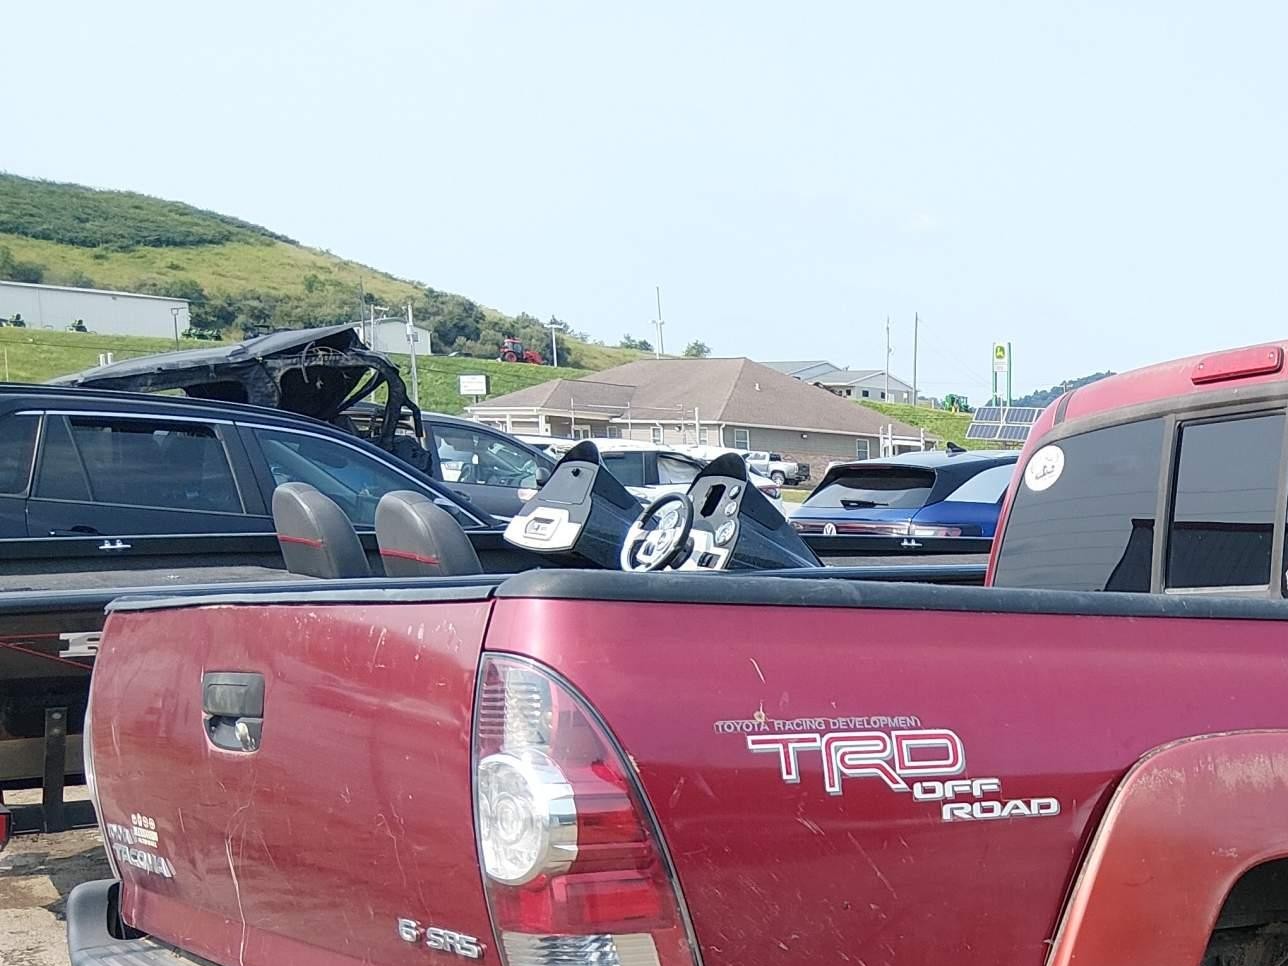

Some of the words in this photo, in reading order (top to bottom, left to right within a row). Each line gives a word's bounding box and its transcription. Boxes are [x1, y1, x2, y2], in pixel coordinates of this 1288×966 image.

[714, 719, 770, 734] TOYOTA
[774, 718, 826, 731] RACING
[747, 728, 967, 796] TRD
[912, 777, 1003, 803] OFF
[941, 797, 1062, 822] ROAD
